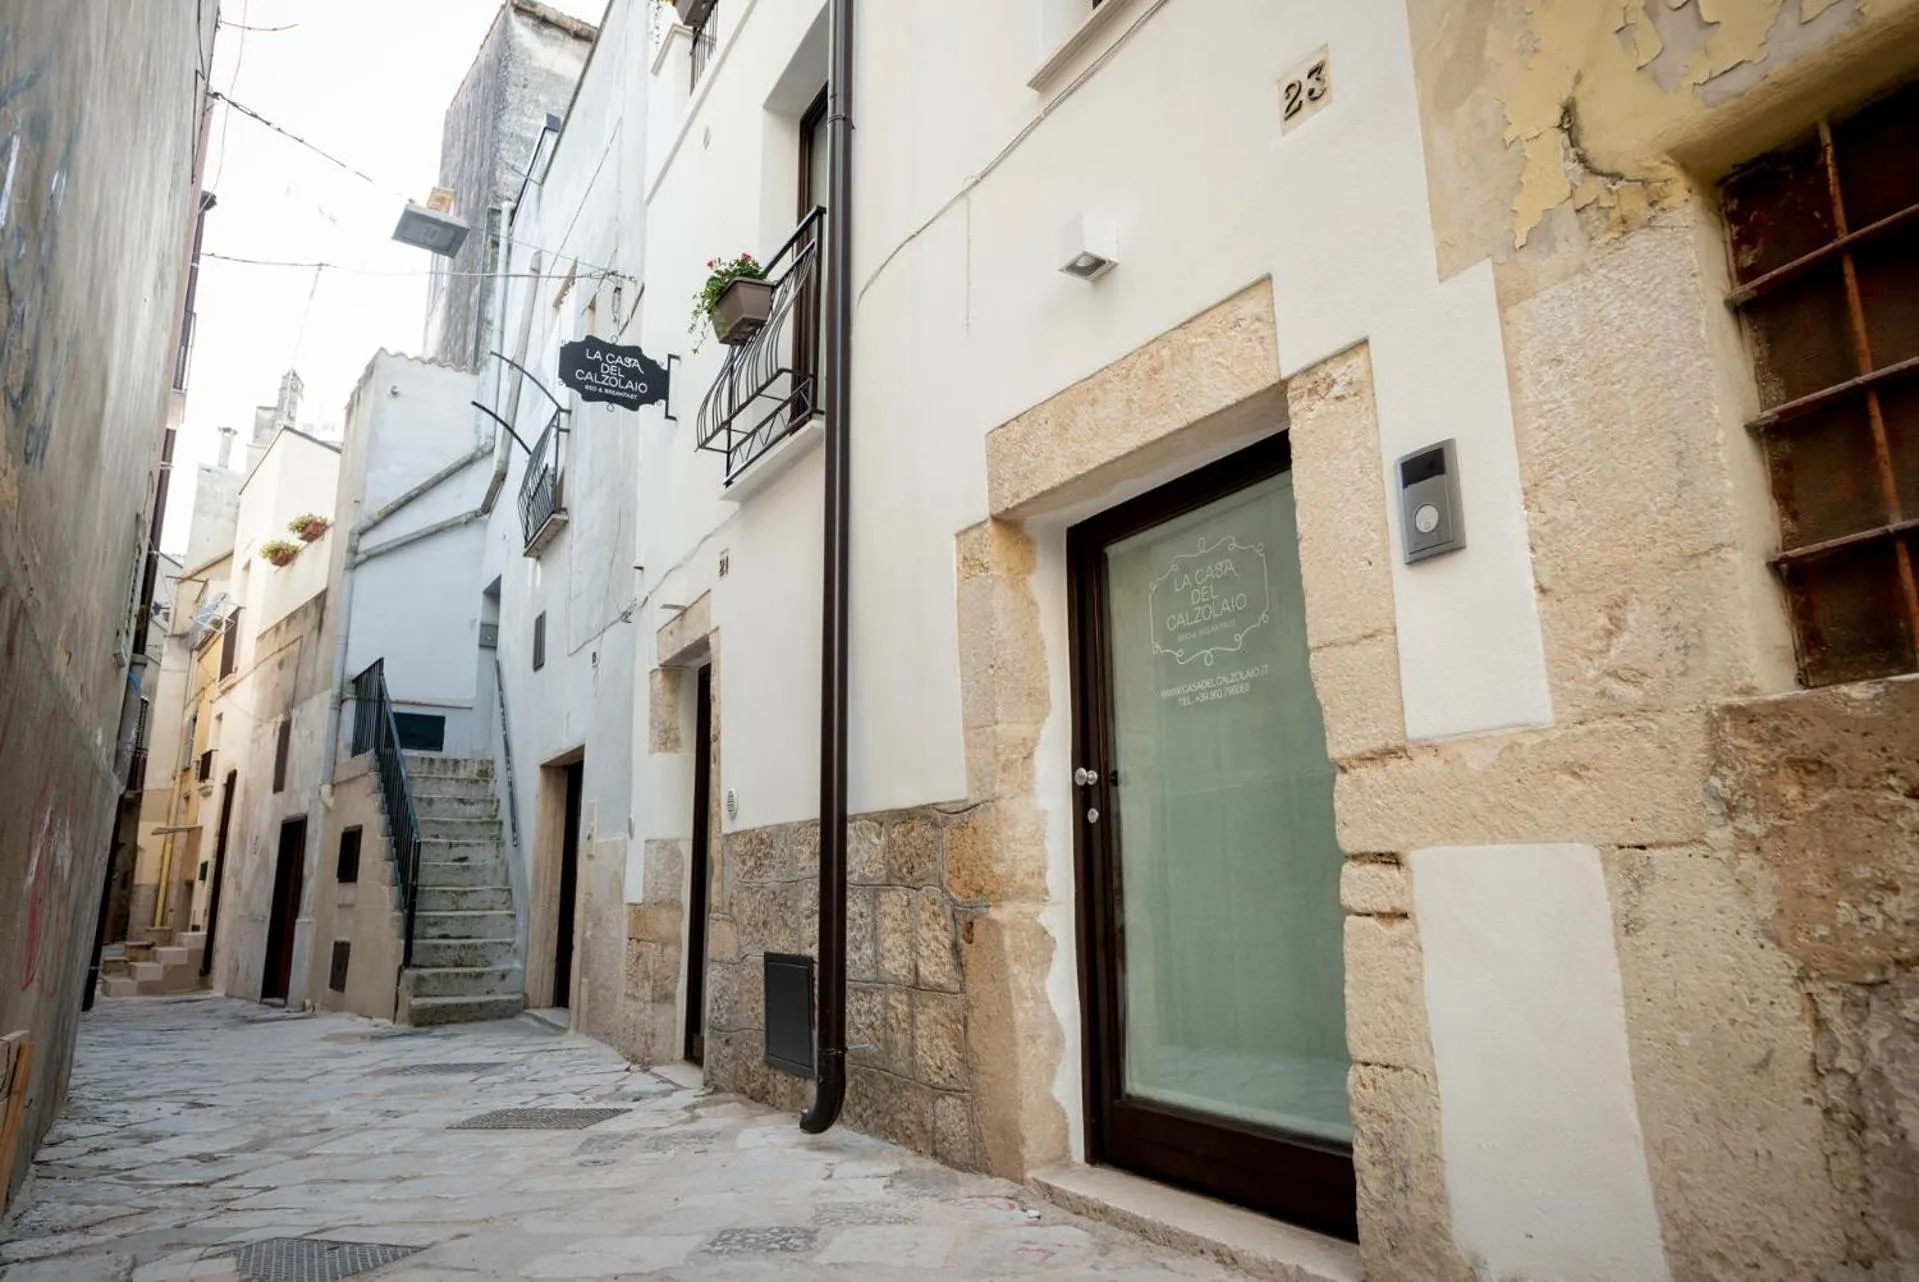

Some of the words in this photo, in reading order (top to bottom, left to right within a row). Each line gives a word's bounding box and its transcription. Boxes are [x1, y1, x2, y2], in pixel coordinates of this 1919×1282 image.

[1284, 60, 1327, 121] 23
[586, 348, 602, 361] LA
[605, 353, 644, 375] CASA
[600, 363, 625, 378] DEL
[575, 369, 648, 393] CALZOLAIO
[1174, 573, 1192, 592] LA
[1195, 558, 1239, 585] CASA
[1191, 583, 1219, 605] DEL
[1166, 592, 1248, 632] CALZOLAIO
